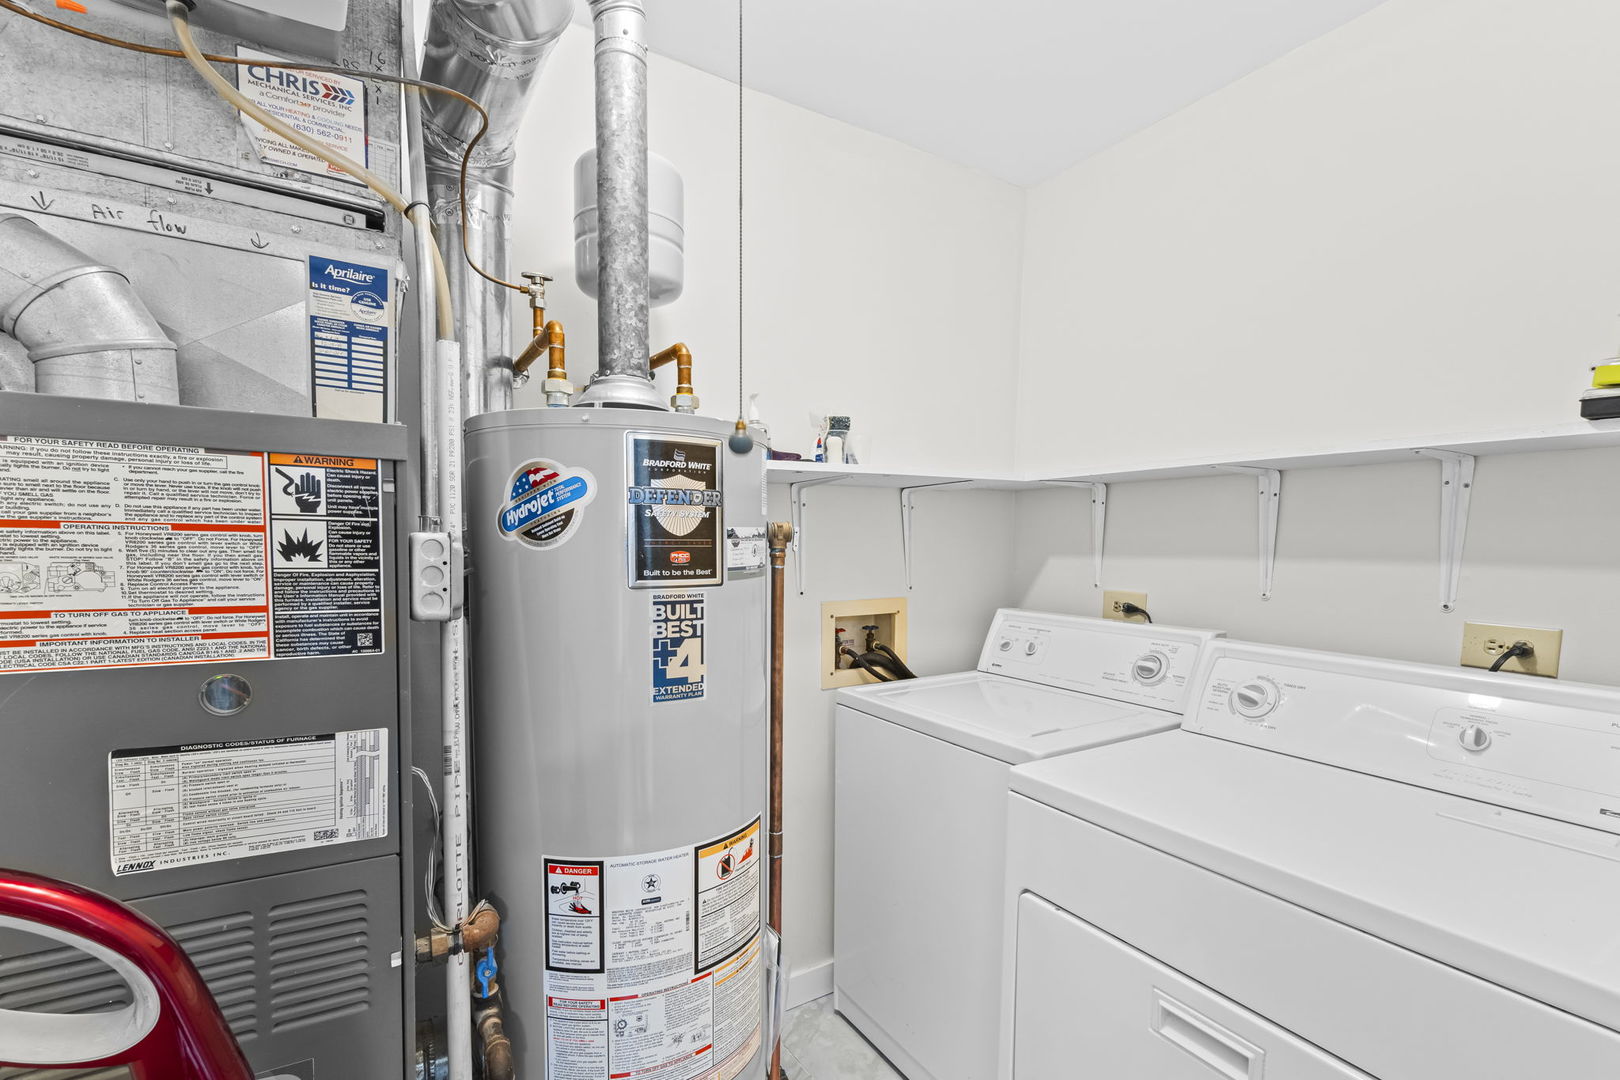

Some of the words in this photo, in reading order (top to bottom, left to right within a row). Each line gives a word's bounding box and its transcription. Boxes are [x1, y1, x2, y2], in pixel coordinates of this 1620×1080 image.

[369, 51, 386, 65] 16
[248, 65, 320, 96] CHRIS
[248, 79, 300, 97] MECHANICAL
[339, 104, 352, 112] INC
[285, 108, 310, 118] HEATING
[317, 115, 344, 127] COOLING
[345, 123, 363, 132] NEEDS
[313, 105, 346, 118] provider
[293, 123, 314, 134] (630)
[317, 129, 352, 144] 562-0911
[307, 119, 344, 133] COMMERCIAL
[268, 146, 291, 155] OWNED
[92, 203, 125, 220] Air
[146, 209, 188, 236] flow
[324, 264, 373, 283] Aprilaire
[328, 284, 350, 293] time?
[121, 443, 154, 451] BEFORE
[156, 445, 199, 454] OPERATING
[304, 456, 354, 467] WARNING
[643, 459, 686, 468] BRADFORD
[688, 462, 712, 471] WHITE
[629, 486, 722, 507] DEFENDER
[506, 490, 555, 526] Hydrojet
[645, 509, 678, 518] SAFETY
[680, 510, 710, 518] SYSTEM
[654, 603, 703, 620] BUILT
[654, 620, 703, 638] BEST
[653, 638, 706, 683] +4
[653, 683, 704, 695] EXTENDED
[181, 743, 223, 751] DIAGNOSTIC
[225, 739, 275, 747] CODES/STATUS
[117, 860, 156, 872] LENNOX
[160, 854, 209, 864] INDUSTRIES
[456, 833, 464, 966] CRLOTTE
